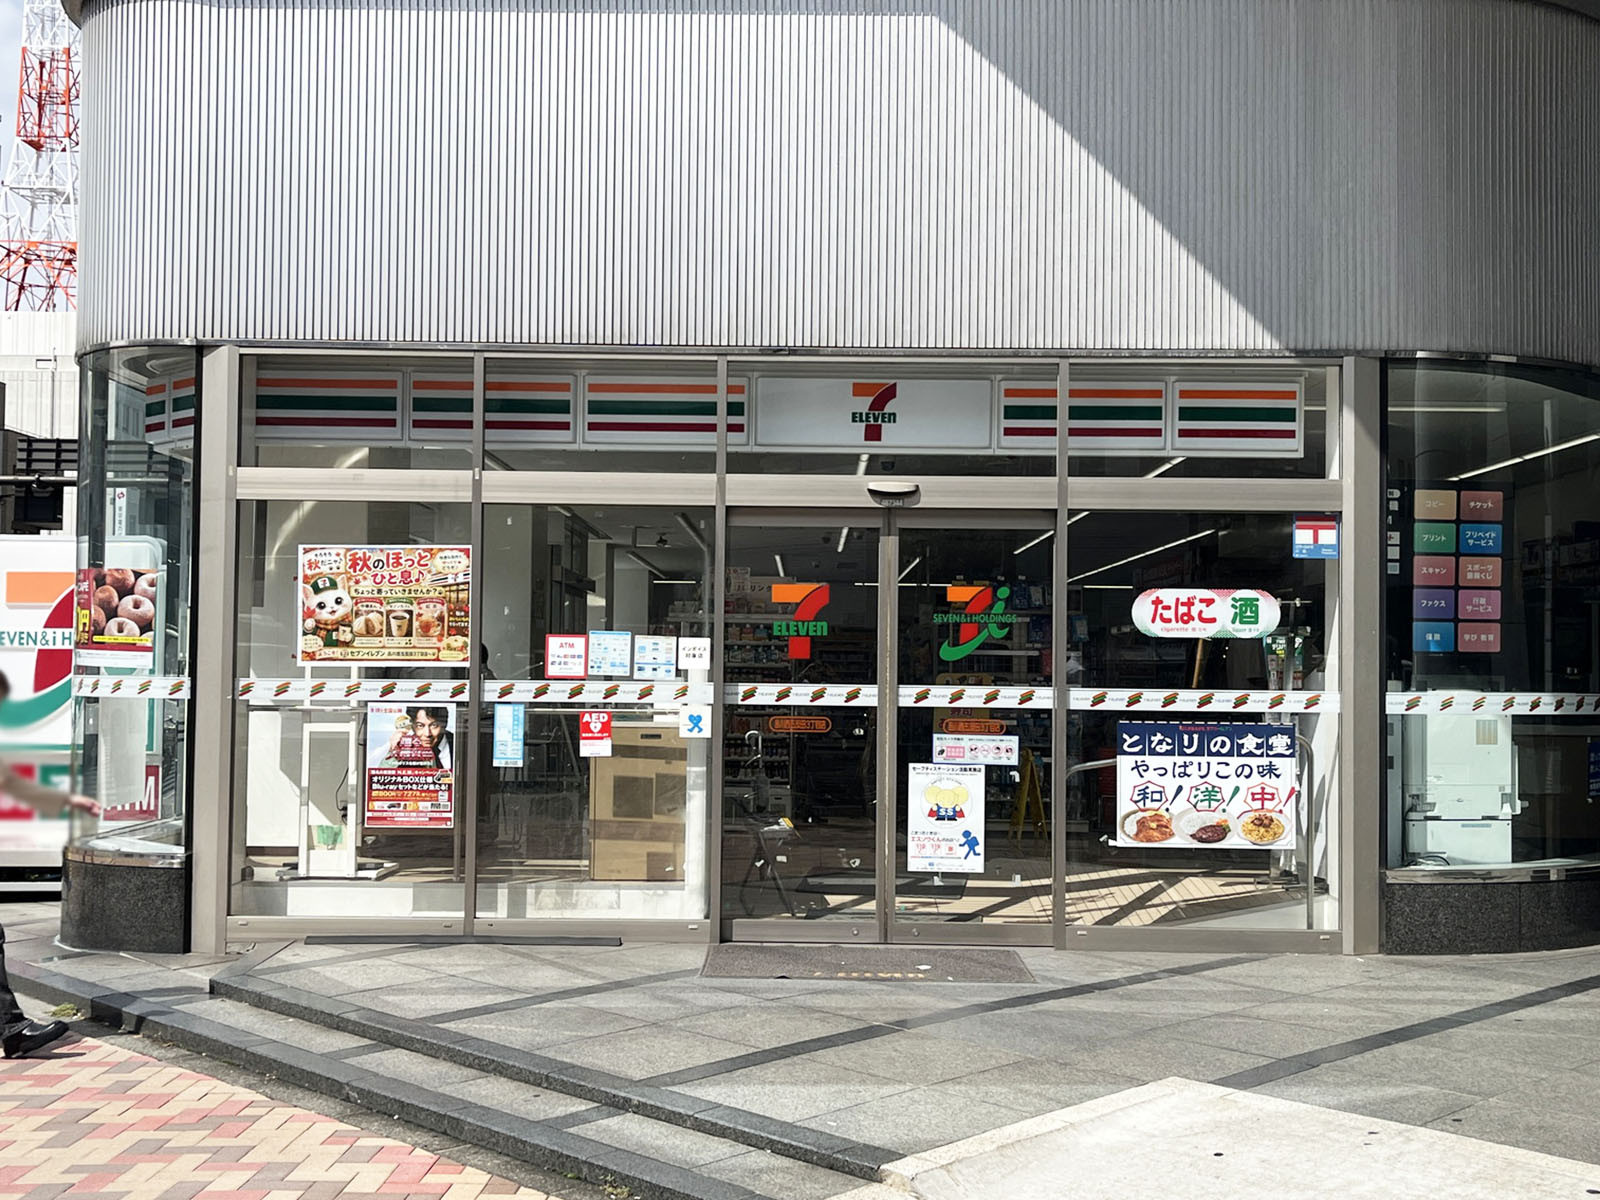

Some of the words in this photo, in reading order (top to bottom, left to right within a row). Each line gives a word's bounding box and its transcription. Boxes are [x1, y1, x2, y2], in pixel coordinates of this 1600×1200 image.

[1469, 501, 1494, 509] チケット
[1422, 534, 1447, 542] プリント
[348, 551, 429, 573] 秋のほっと
[1421, 566, 1447, 574] スキャン
[1151, 595, 1217, 625] たばこ
[1231, 596, 1260, 625] 酒
[1466, 605, 1493, 613] サービス
[972, 614, 1017, 623] HOLDINGS
[582, 712, 609, 722] AED
[1122, 732, 1294, 755] となりの食堂
[1131, 759, 1282, 780] やっぱりこの味
[939, 808, 954, 816] SS
